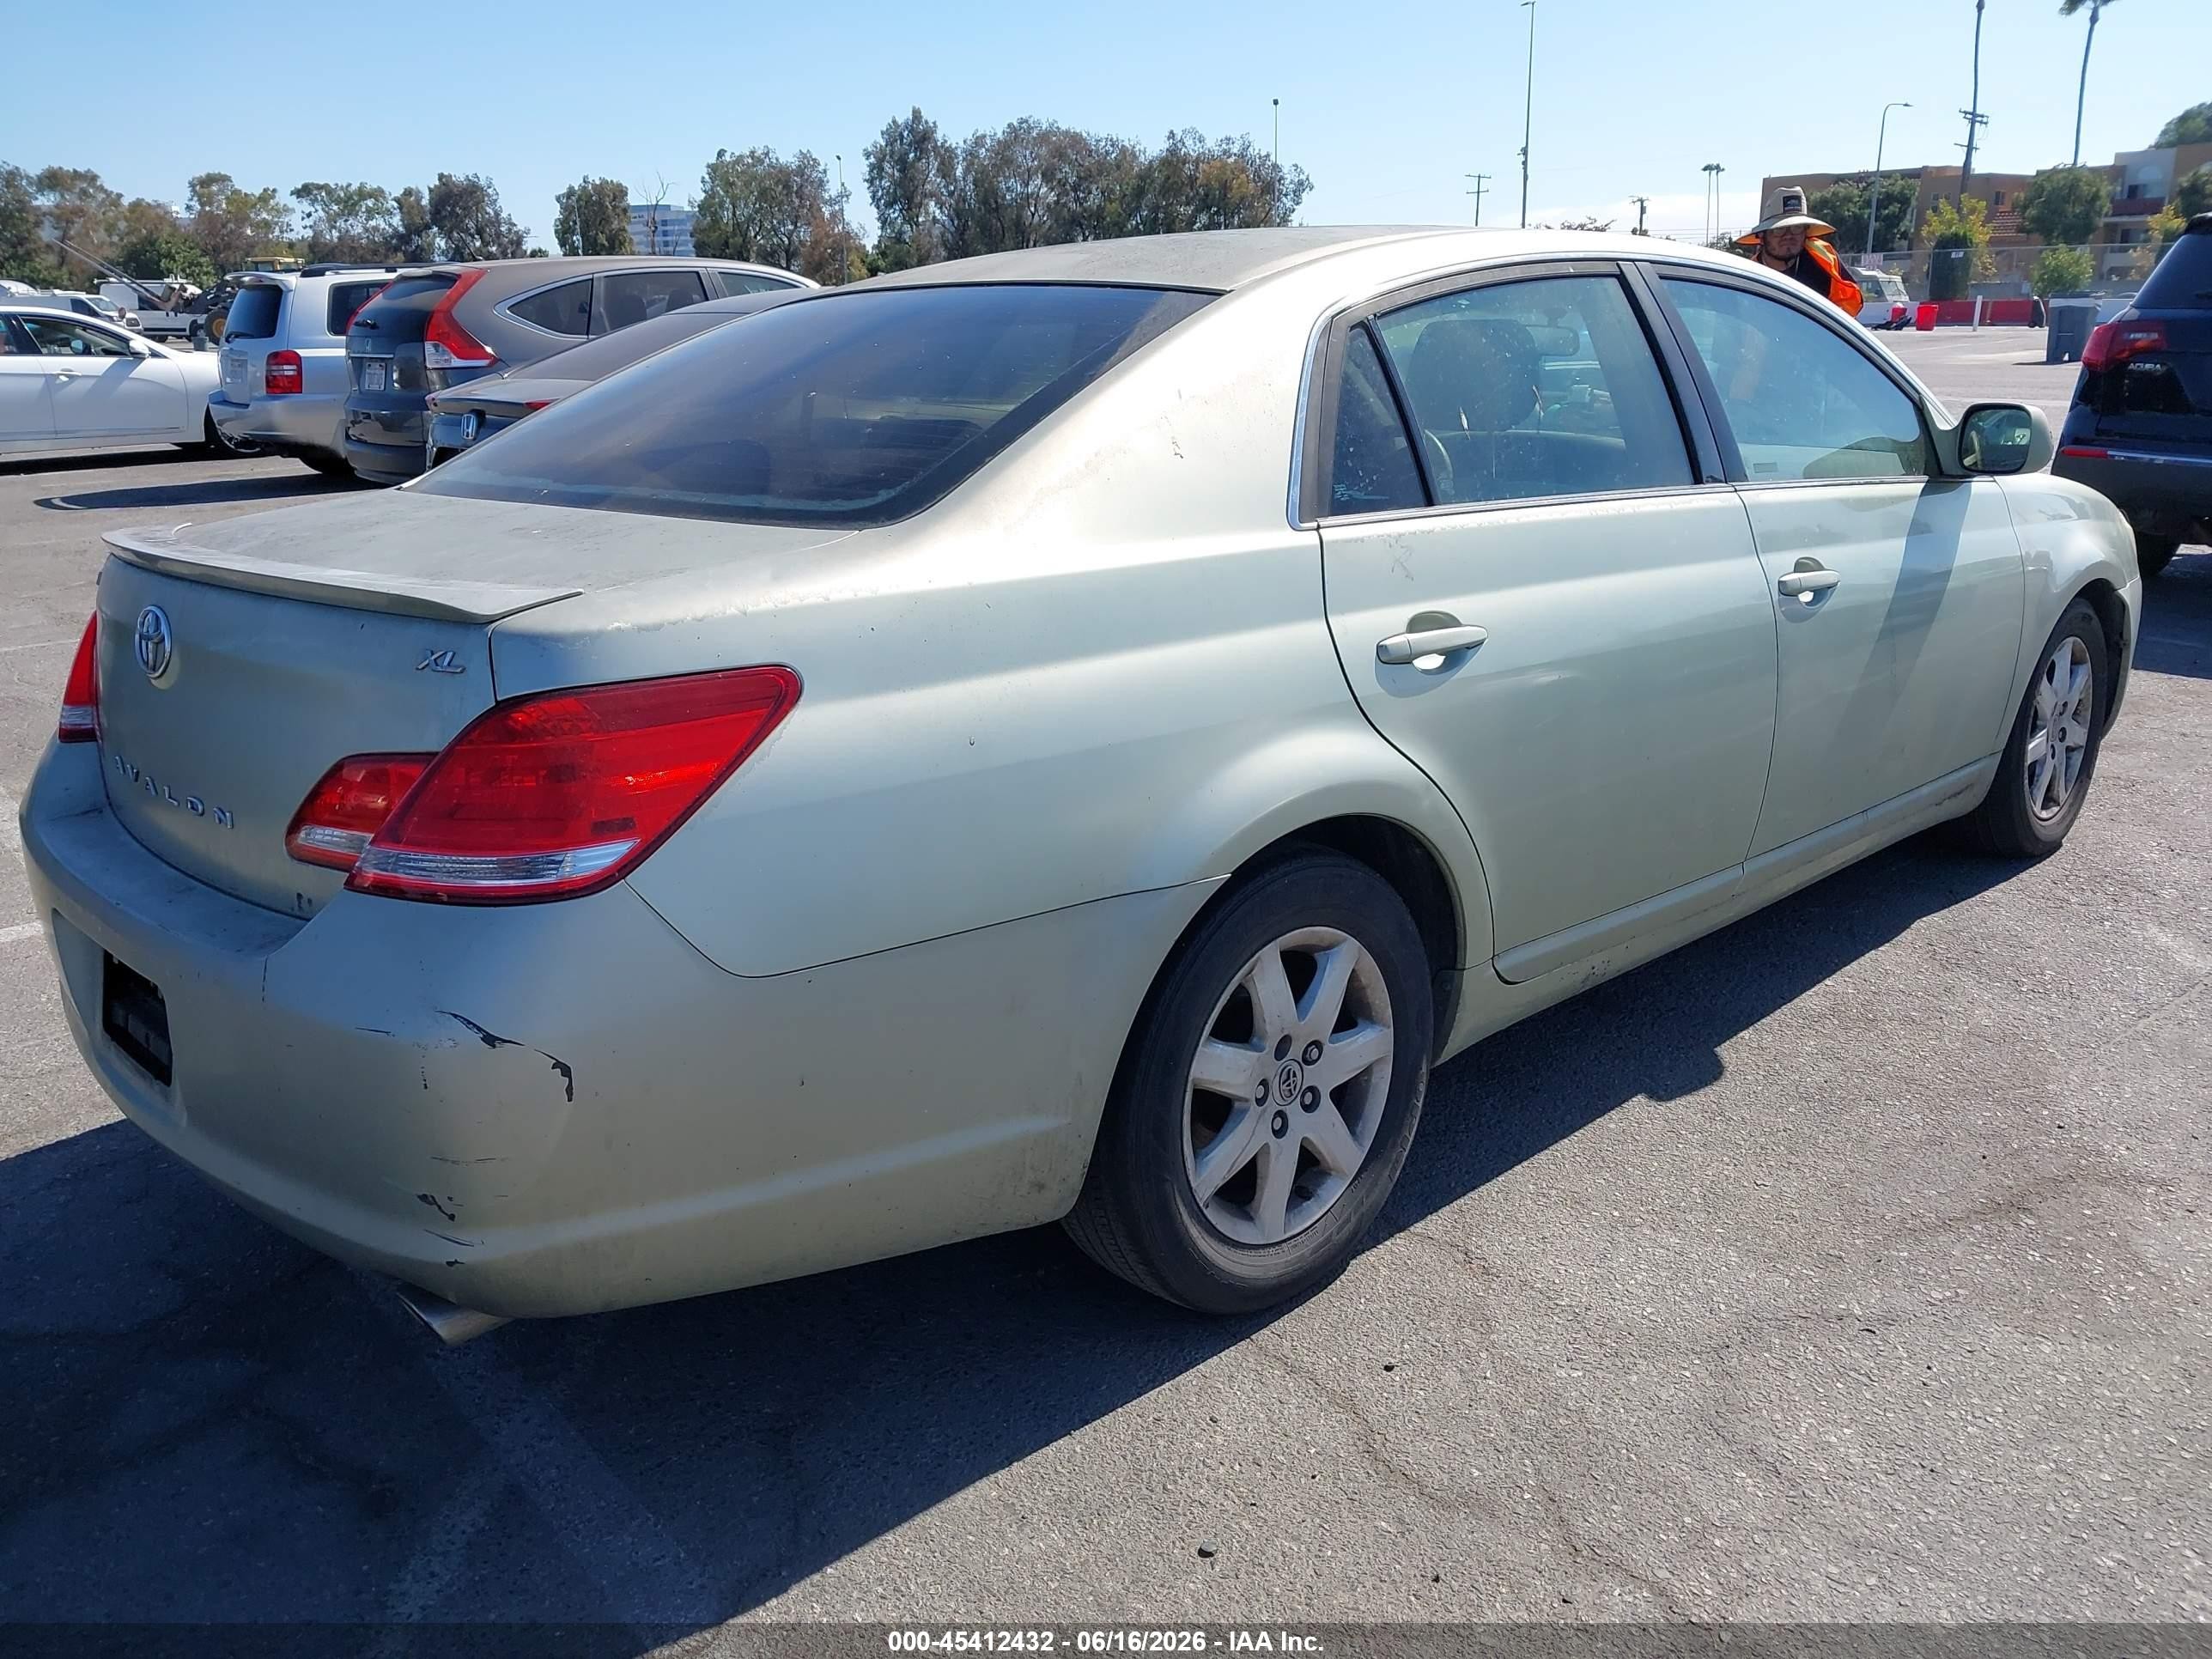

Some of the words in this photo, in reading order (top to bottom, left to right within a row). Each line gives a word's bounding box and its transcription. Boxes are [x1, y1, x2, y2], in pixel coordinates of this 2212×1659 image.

[2129, 362, 2162, 371] ACURA
[416, 649, 466, 674] XL
[115, 755, 234, 830] AVALON
